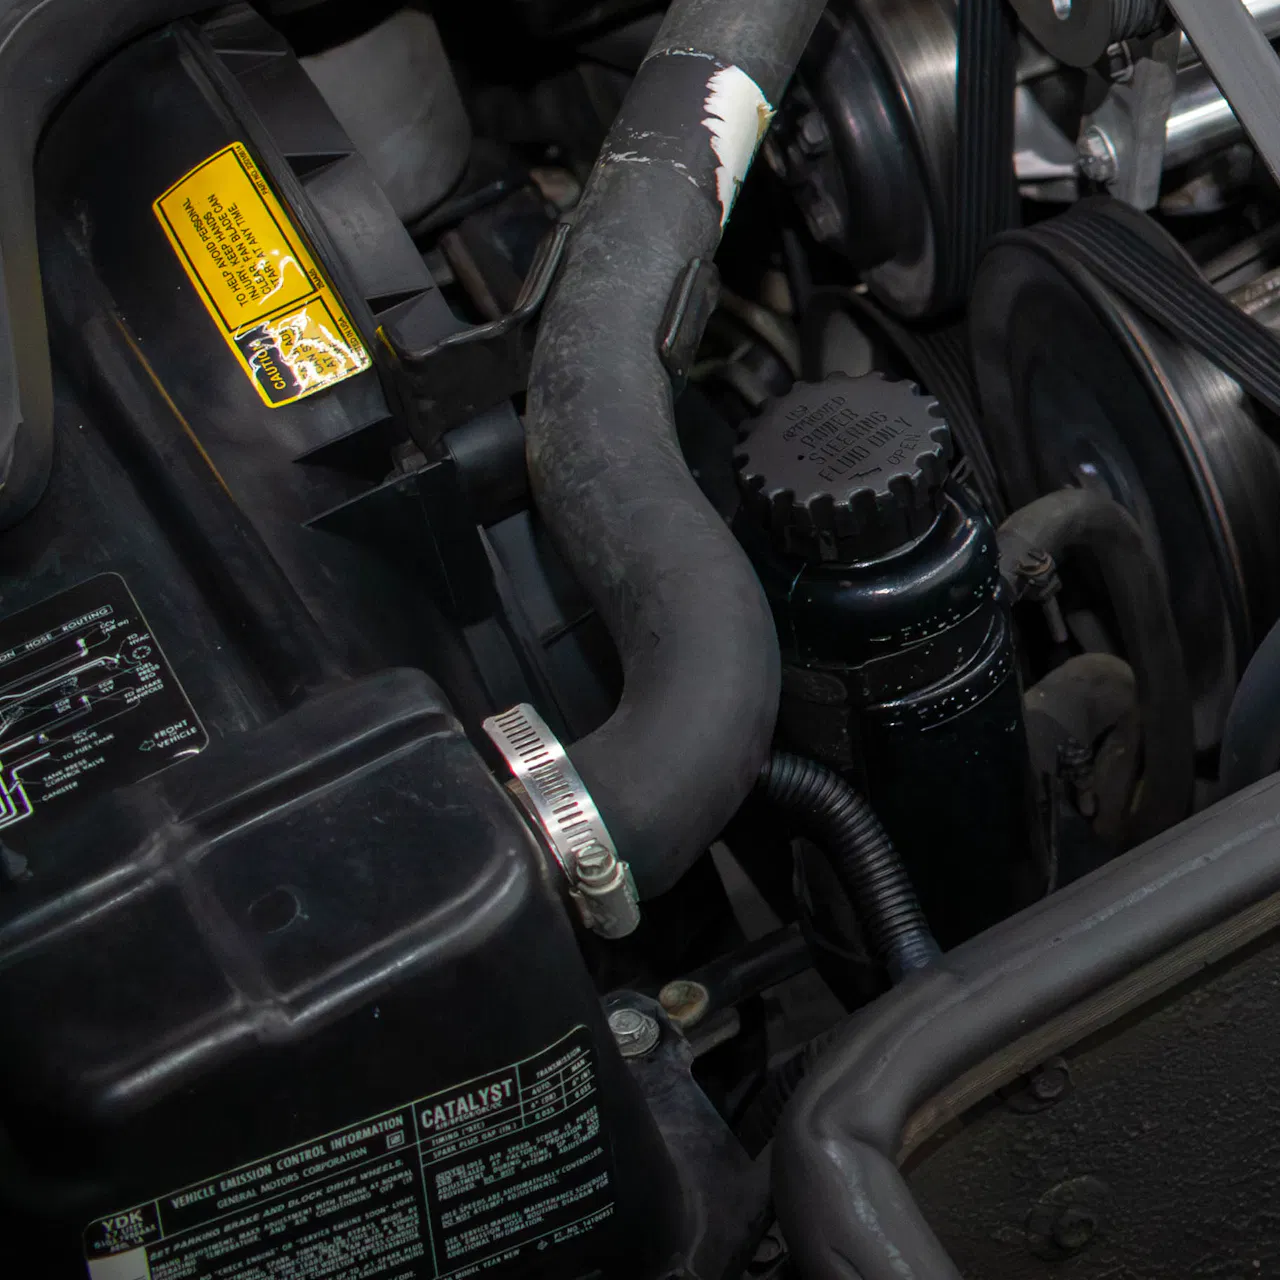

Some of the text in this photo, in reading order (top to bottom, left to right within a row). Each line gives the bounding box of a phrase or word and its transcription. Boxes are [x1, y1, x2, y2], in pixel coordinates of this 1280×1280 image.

[256, 179, 269, 195] PART
[207, 193, 224, 213] CAN
[226, 201, 245, 225] TIME.
[218, 212, 241, 242] BLADE
[239, 224, 257, 245] ANY
[181, 197, 249, 306] TO HELP AVOID PERSONAL
[202, 210, 260, 300] INJURY, KEEP HANDS
[236, 242, 252, 261] FAN
[251, 245, 265, 260] AT
[806, 411, 889, 464] STEERING
[817, 417, 912, 481] FLUID ONLY
[24, 605, 108, 651] HOSE ROUTING
[153, 718, 188, 740] FRONT
[156, 725, 197, 749] VEHICLE
[421, 1078, 514, 1129] CATALYST
[172, 1114, 403, 1209] VEHICLE EMISSION CONTROL INFORMATION
[217, 1145, 366, 1210] GENERAL MOTORS CORPORATION
[262, 1202, 285, 1218] AND
[288, 1188, 323, 1209] BLOCK
[326, 1175, 356, 1194] DRIVE
[102, 1209, 141, 1234] YDK
